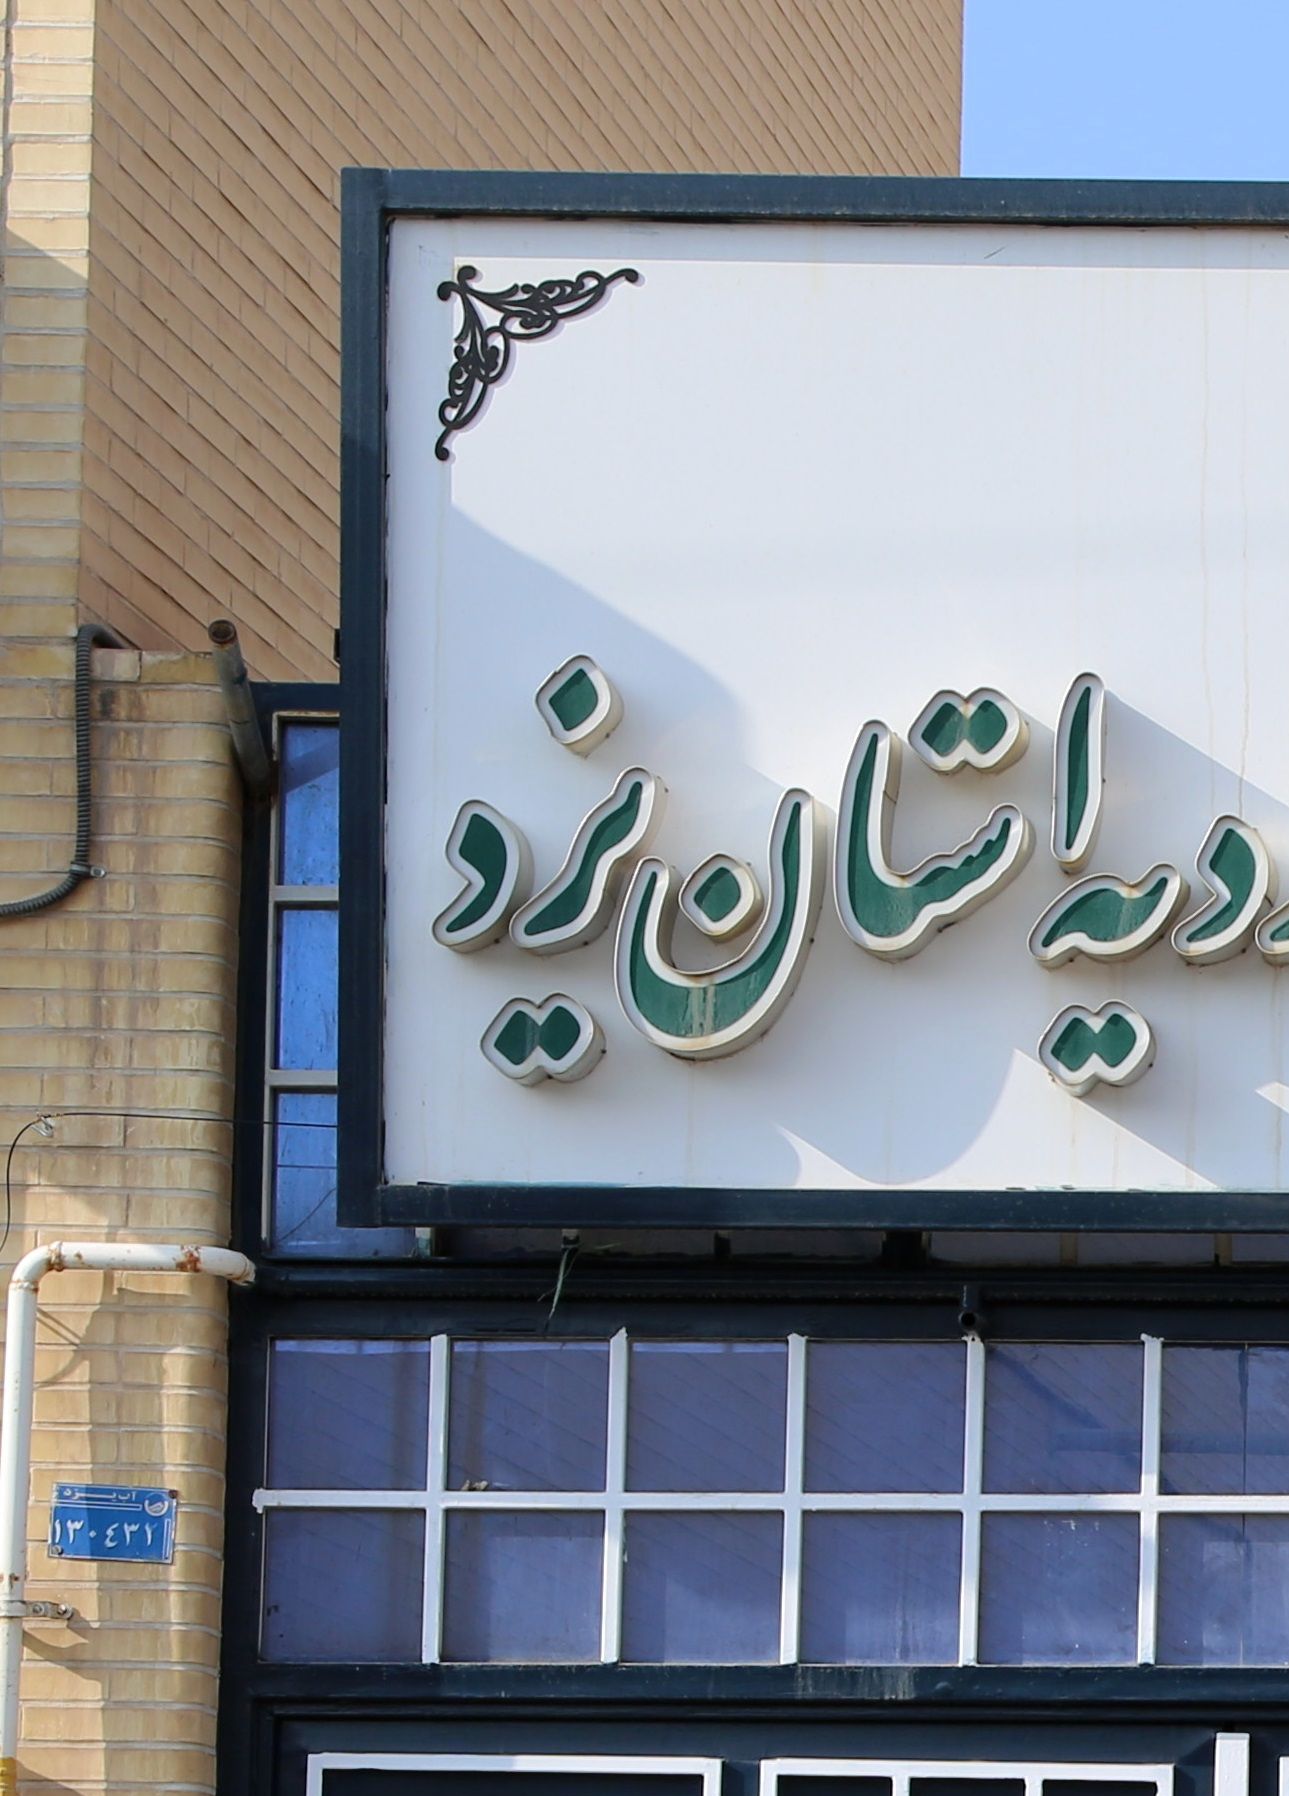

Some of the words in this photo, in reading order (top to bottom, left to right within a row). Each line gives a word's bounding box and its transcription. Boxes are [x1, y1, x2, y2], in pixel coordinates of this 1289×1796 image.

[431, 654, 670, 1087] یزد
[614, 672, 1108, 1063] استان
[1028, 814, 1277, 1098] دیه
